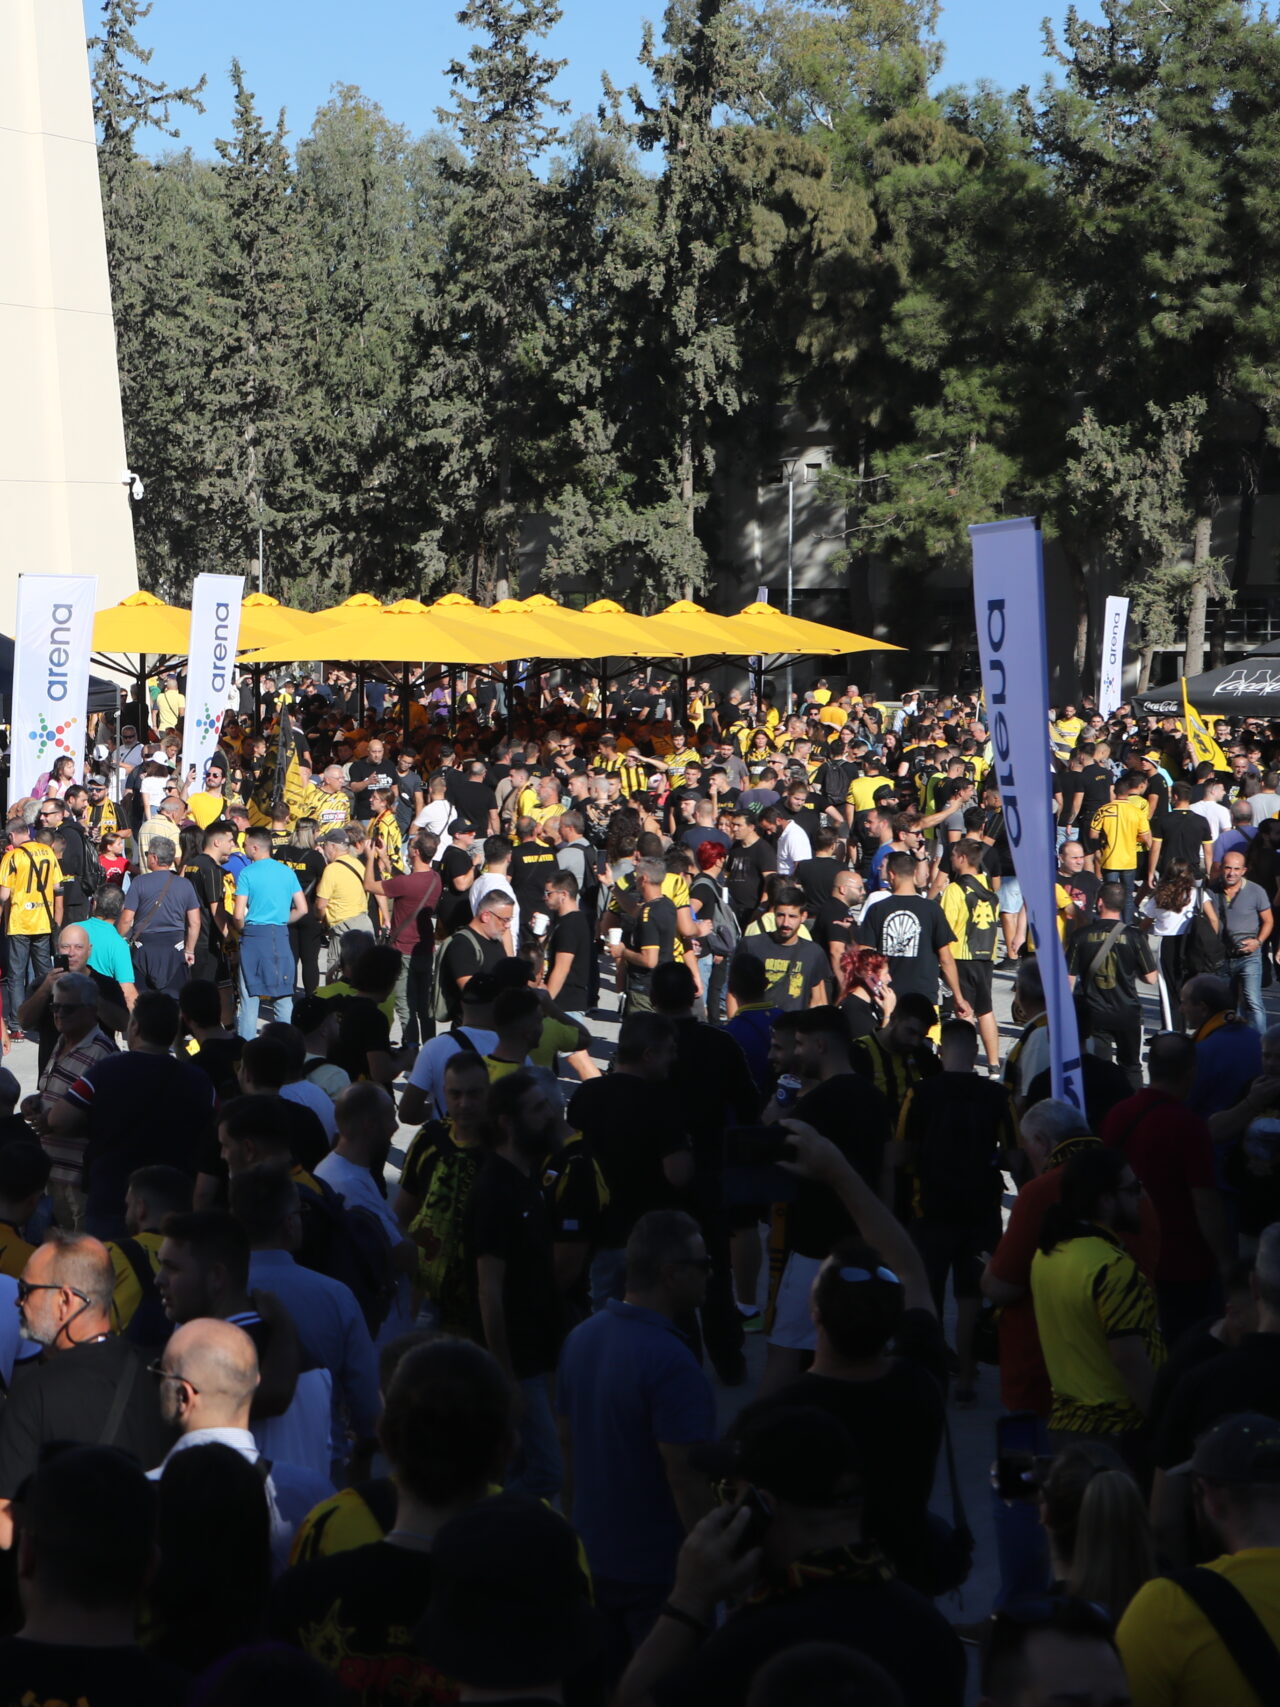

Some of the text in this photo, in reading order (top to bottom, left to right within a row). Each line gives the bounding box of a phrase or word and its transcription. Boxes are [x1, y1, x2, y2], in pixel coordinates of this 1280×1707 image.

[47, 603, 73, 701] arena
[212, 602, 229, 693] arena
[1110, 613, 1121, 665] arena
[1143, 700, 1179, 713] Coca-Cola
